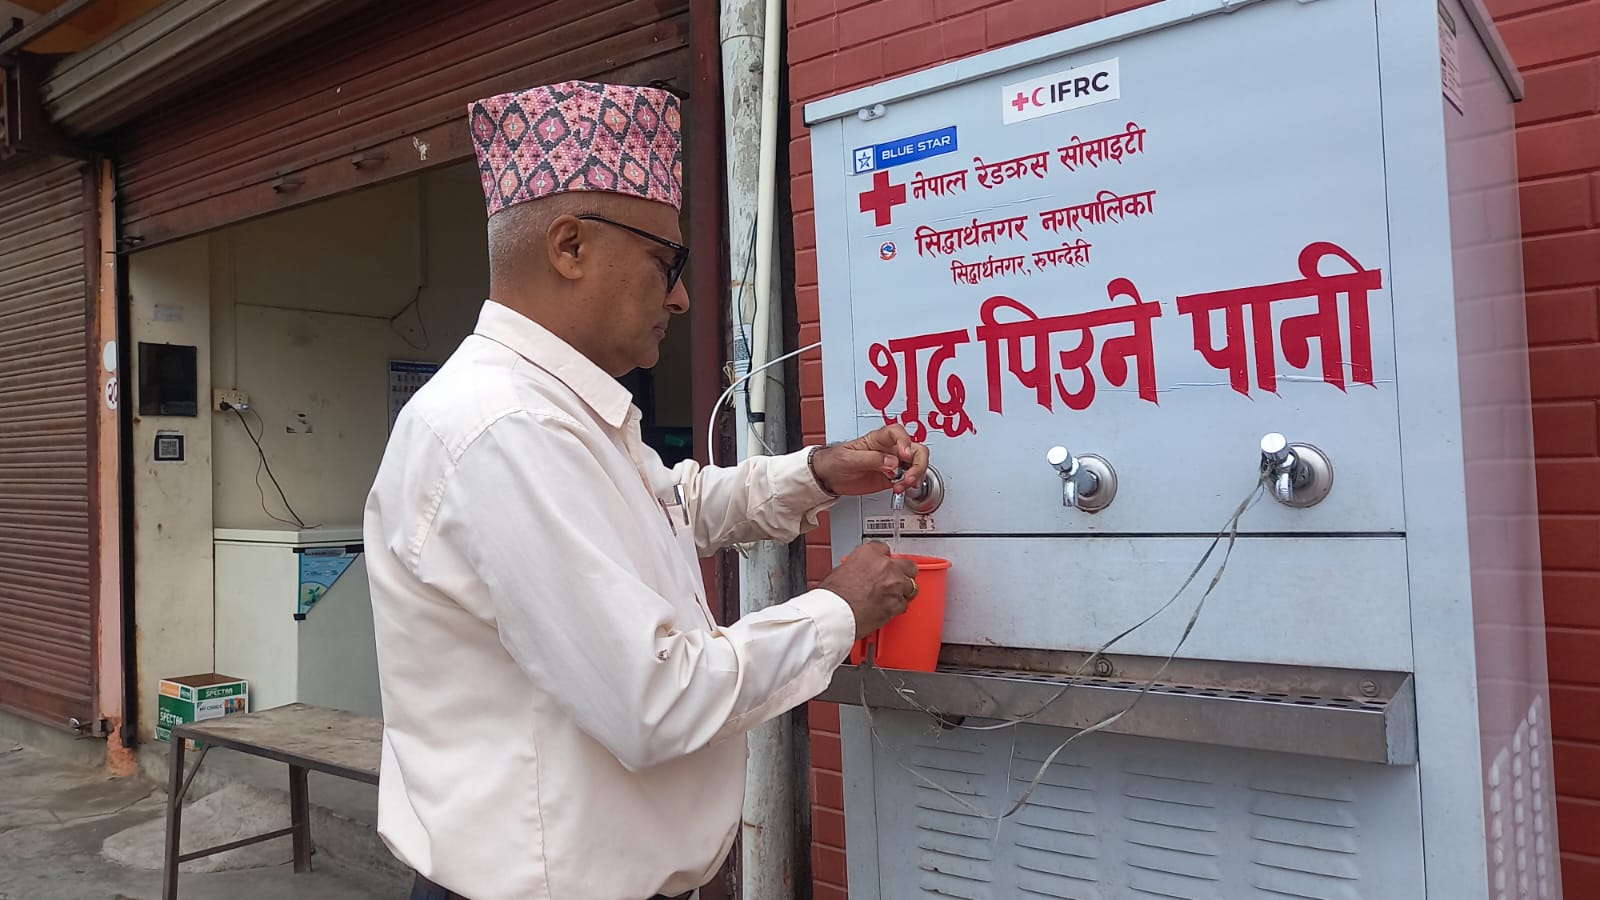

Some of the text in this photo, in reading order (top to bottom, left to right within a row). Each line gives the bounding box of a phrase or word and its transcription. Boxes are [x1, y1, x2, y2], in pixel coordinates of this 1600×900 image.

[1049, 71, 1110, 104] IFRC
[881, 135, 951, 161] BLUE STAR
[910, 121, 1147, 201] नेपाल रेडक्रस सोसाइटी
[1039, 190, 1156, 235] नगरपालिका
[976, 277, 1162, 415] पिउने
[1176, 241, 1382, 400] पानी
